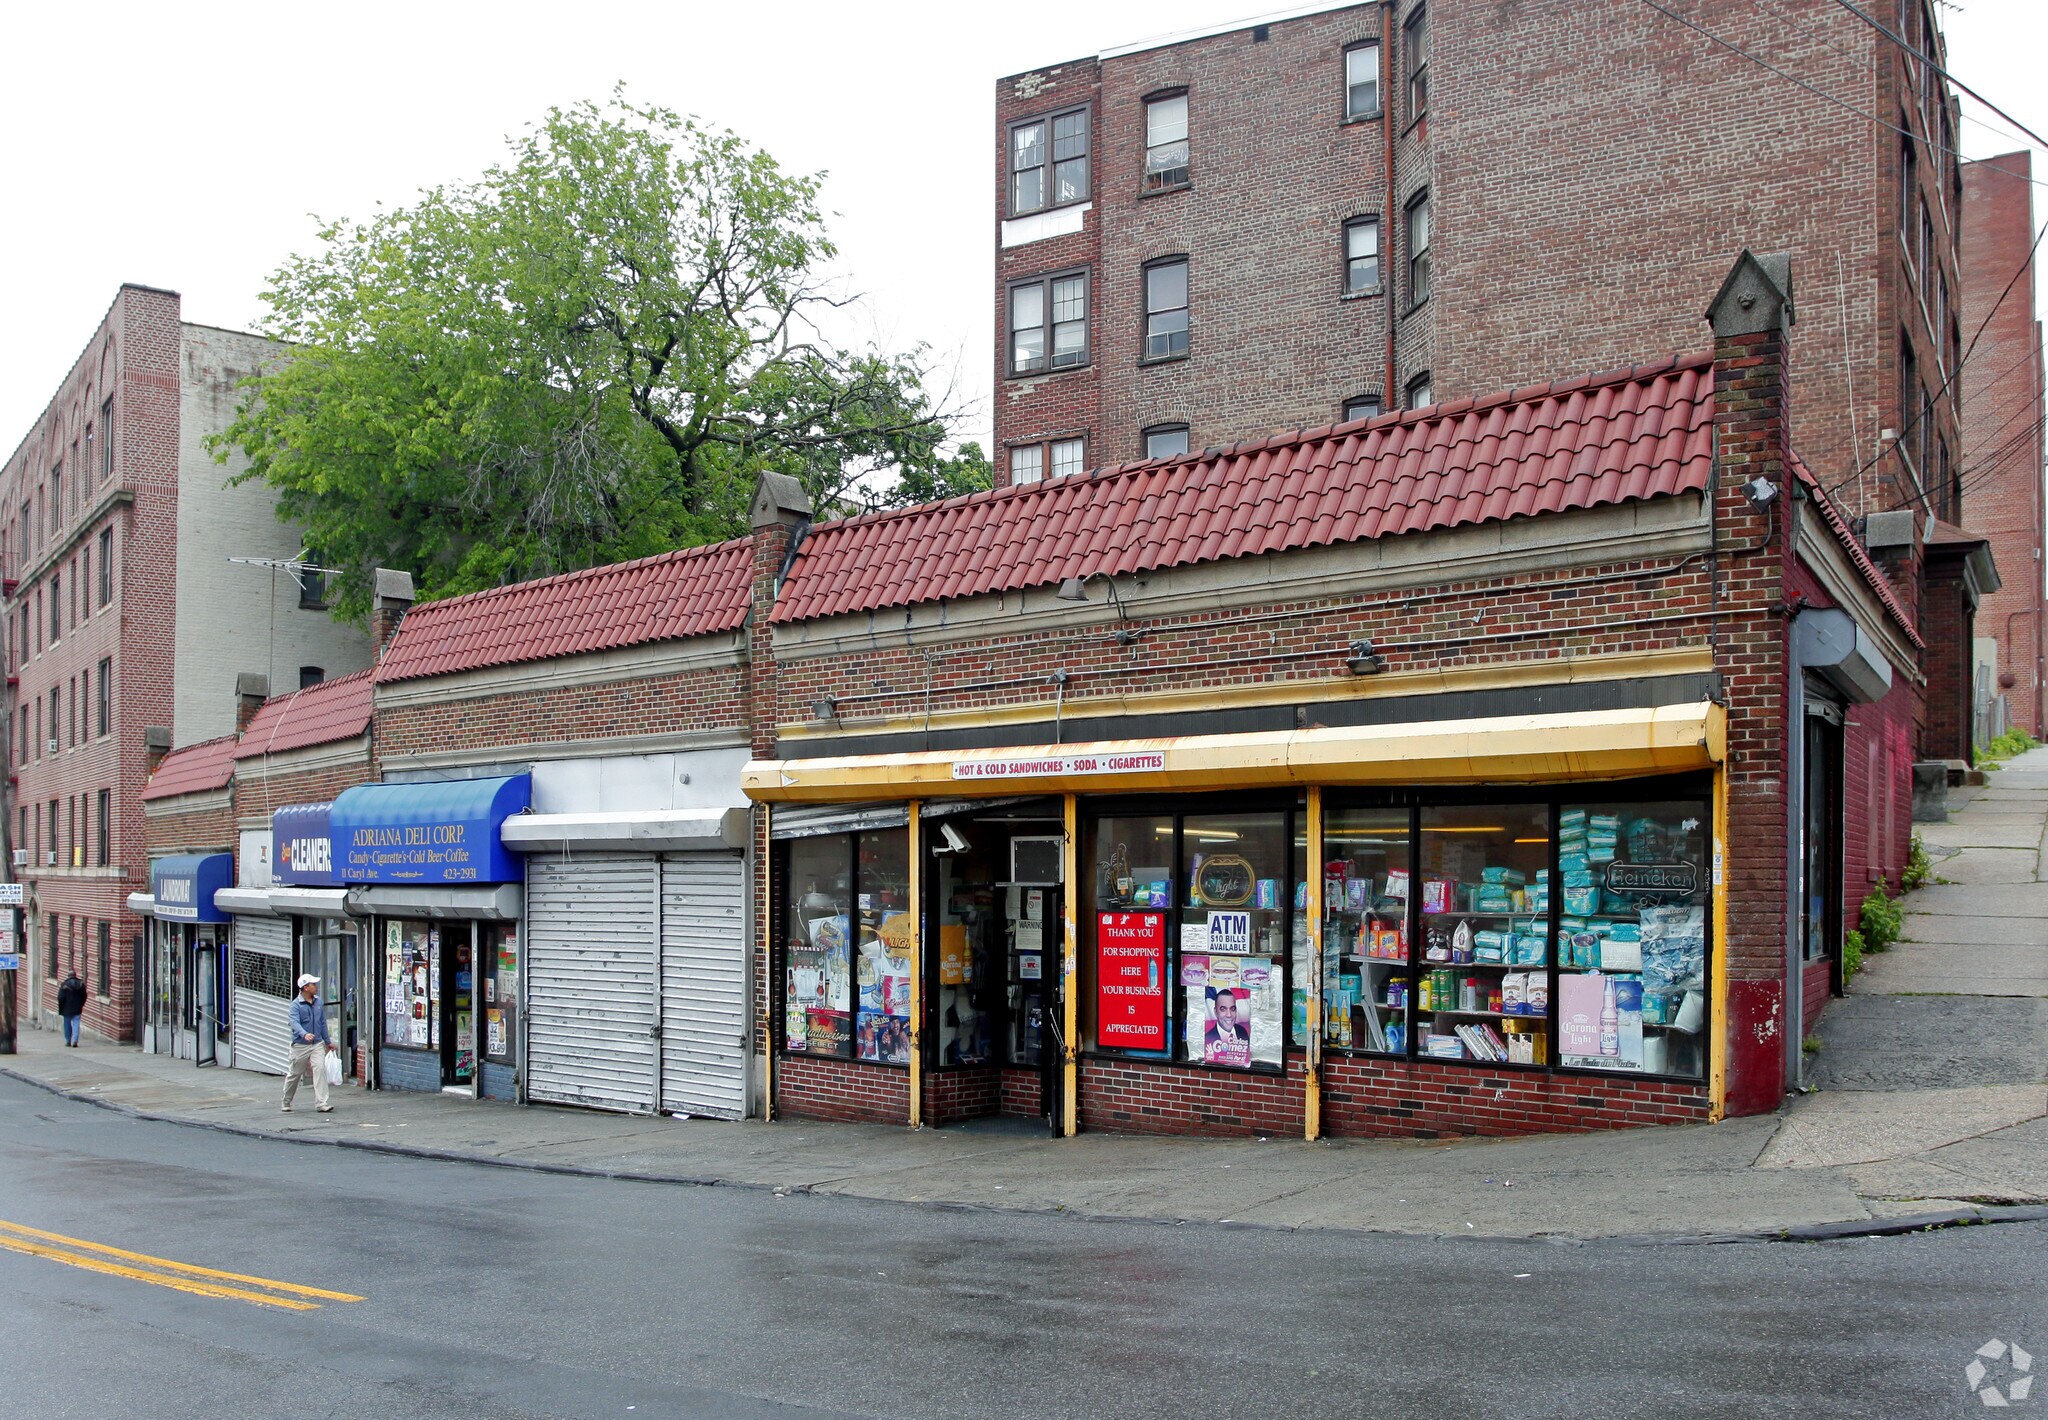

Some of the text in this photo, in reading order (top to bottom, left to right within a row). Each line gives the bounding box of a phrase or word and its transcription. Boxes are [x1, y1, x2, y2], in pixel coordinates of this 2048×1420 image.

[958, 755, 1162, 776] HOT & COLD SANDWICHES SODA CIGARETTES
[352, 825, 466, 846] ADRIANA DELI CORP.
[443, 868, 476, 880] 423-2931
[1613, 870, 1692, 886] Heineken
[160, 878, 190, 902] LAUNDROMAT
[1018, 920, 1043, 930] WARNING
[1210, 915, 1246, 934] ATM
[1108, 928, 1154, 938] THANK YOU
[890, 938, 910, 948] LIGH
[1210, 934, 1246, 943] $10 BILLS
[1104, 948, 1160, 957] FOR SHOPPING
[1210, 943, 1246, 952] AVAILABLE
[1120, 967, 1142, 976] HERE
[1102, 986, 1161, 996] YOUR BUSINESS
[1128, 1006, 1136, 1014] IS
[1106, 1024, 1158, 1034] APPRECIATED
[1562, 1022, 1597, 1034] Corona
[807, 1025, 850, 1042] udweiser
[1228, 1036, 1248, 1046] Carlos
[1571, 1034, 1590, 1044] Light
